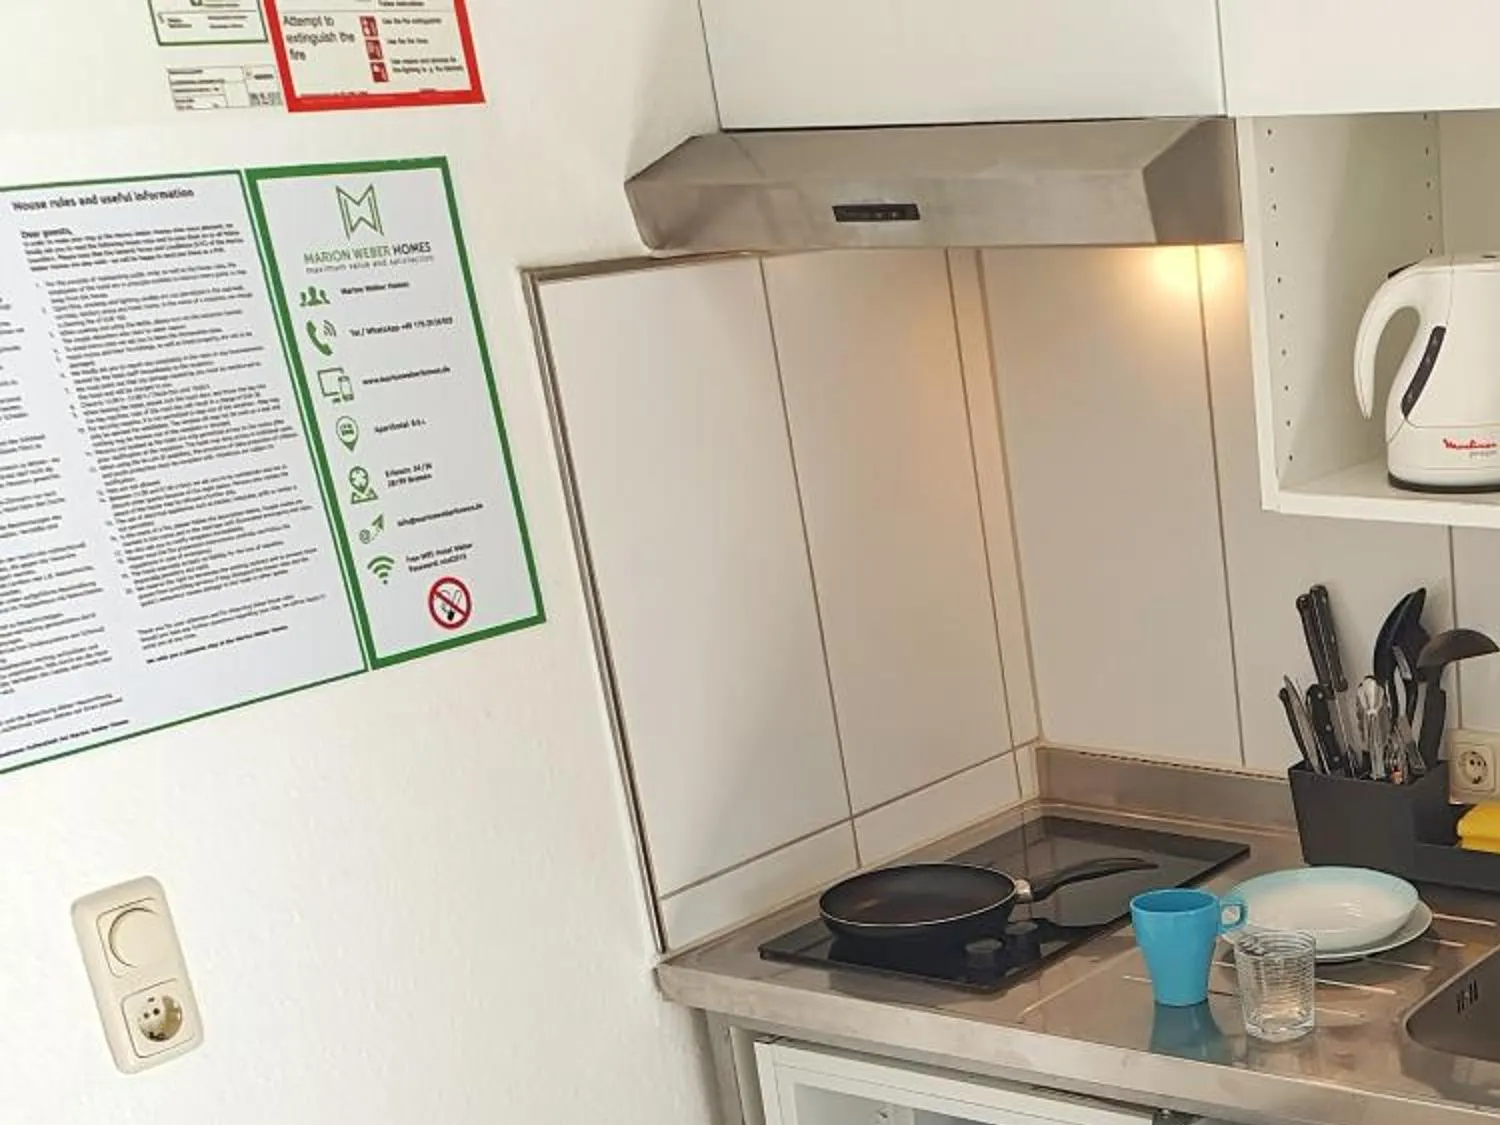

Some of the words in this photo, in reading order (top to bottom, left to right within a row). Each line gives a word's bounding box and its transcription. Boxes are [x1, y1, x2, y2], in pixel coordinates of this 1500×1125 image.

[283, 16, 322, 28] Attempt
[326, 16, 335, 26] to
[286, 32, 336, 46] extinguish
[339, 32, 355, 42] the
[290, 50, 306, 60] fire
[12, 201, 47, 211] House
[49, 197, 76, 208] rules
[79, 194, 98, 206] and
[100, 191, 132, 204] useful
[134, 188, 194, 201] information
[304, 250, 351, 264] MARION
[352, 246, 390, 258] WEBER
[392, 242, 431, 254] HOMES
